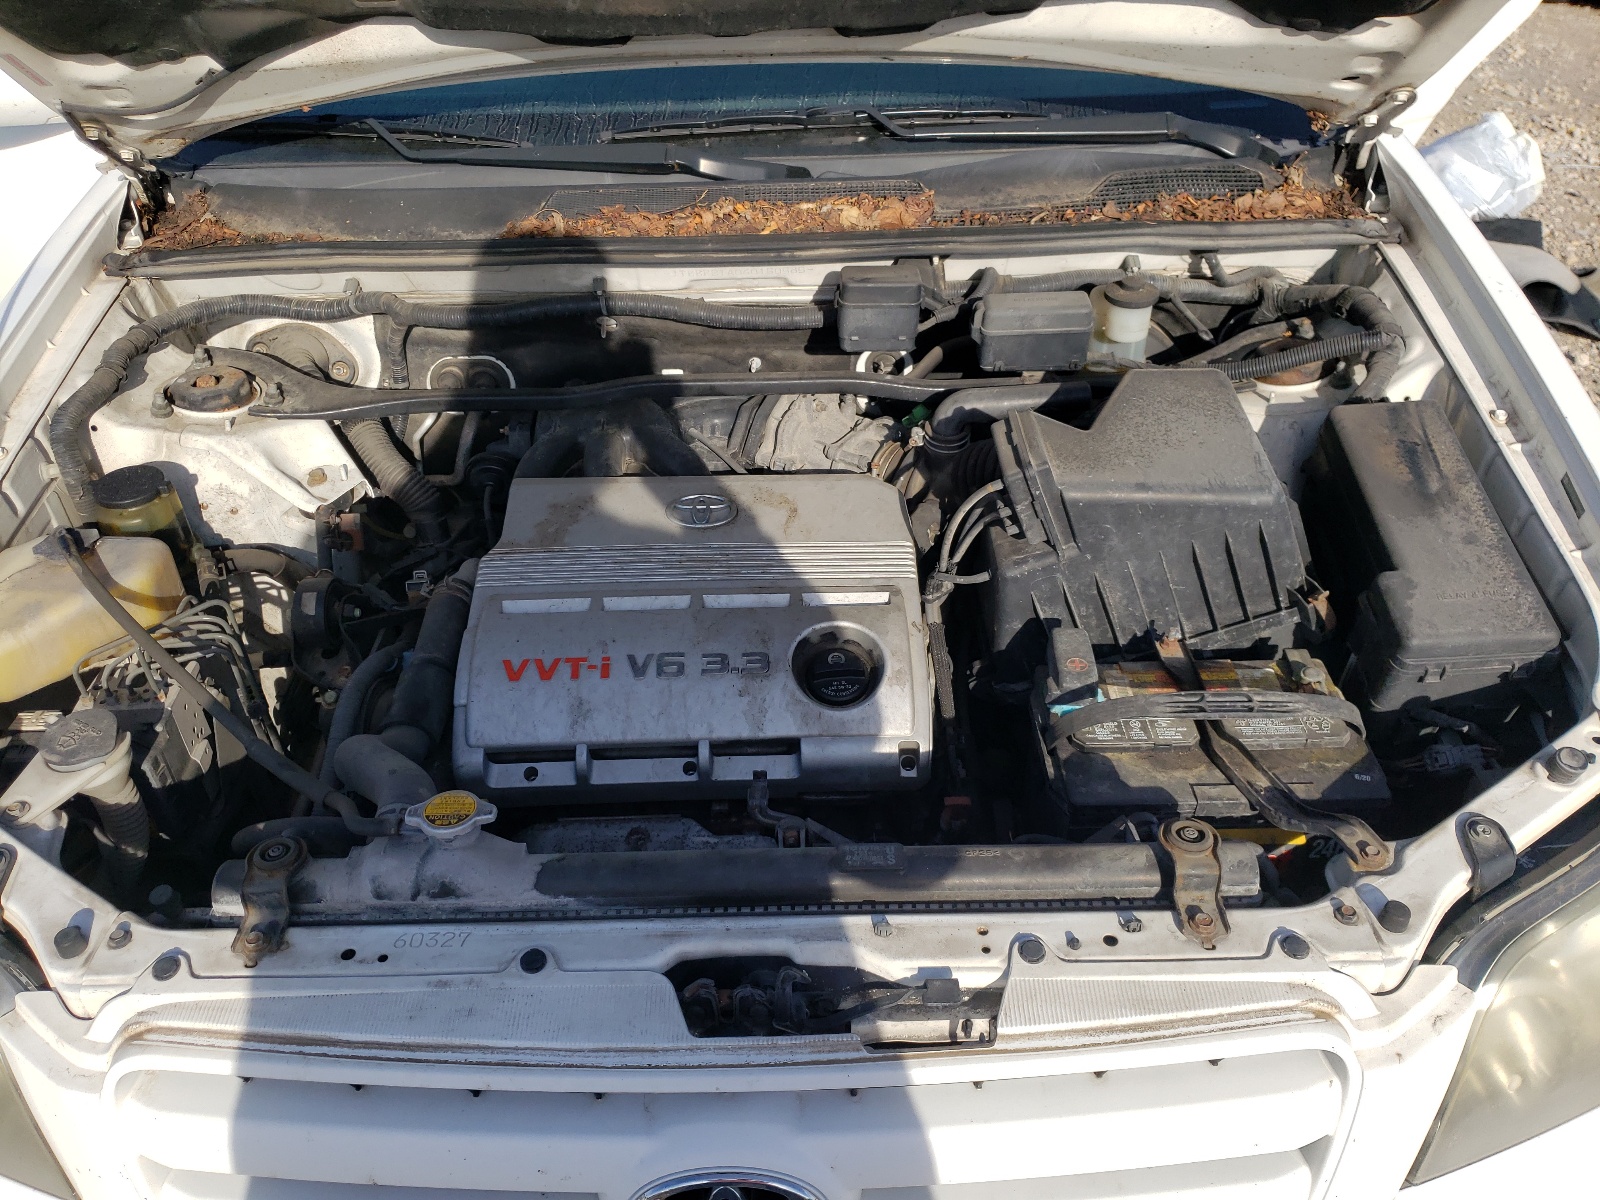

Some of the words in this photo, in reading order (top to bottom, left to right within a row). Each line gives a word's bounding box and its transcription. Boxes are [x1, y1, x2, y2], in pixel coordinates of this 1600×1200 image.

[502, 656, 611, 682] VVT-i
[626, 652, 685, 680] V6
[701, 651, 770, 676] 3.3
[1354, 773, 1371, 782] 6/20
[393, 931, 472, 949] 60327
